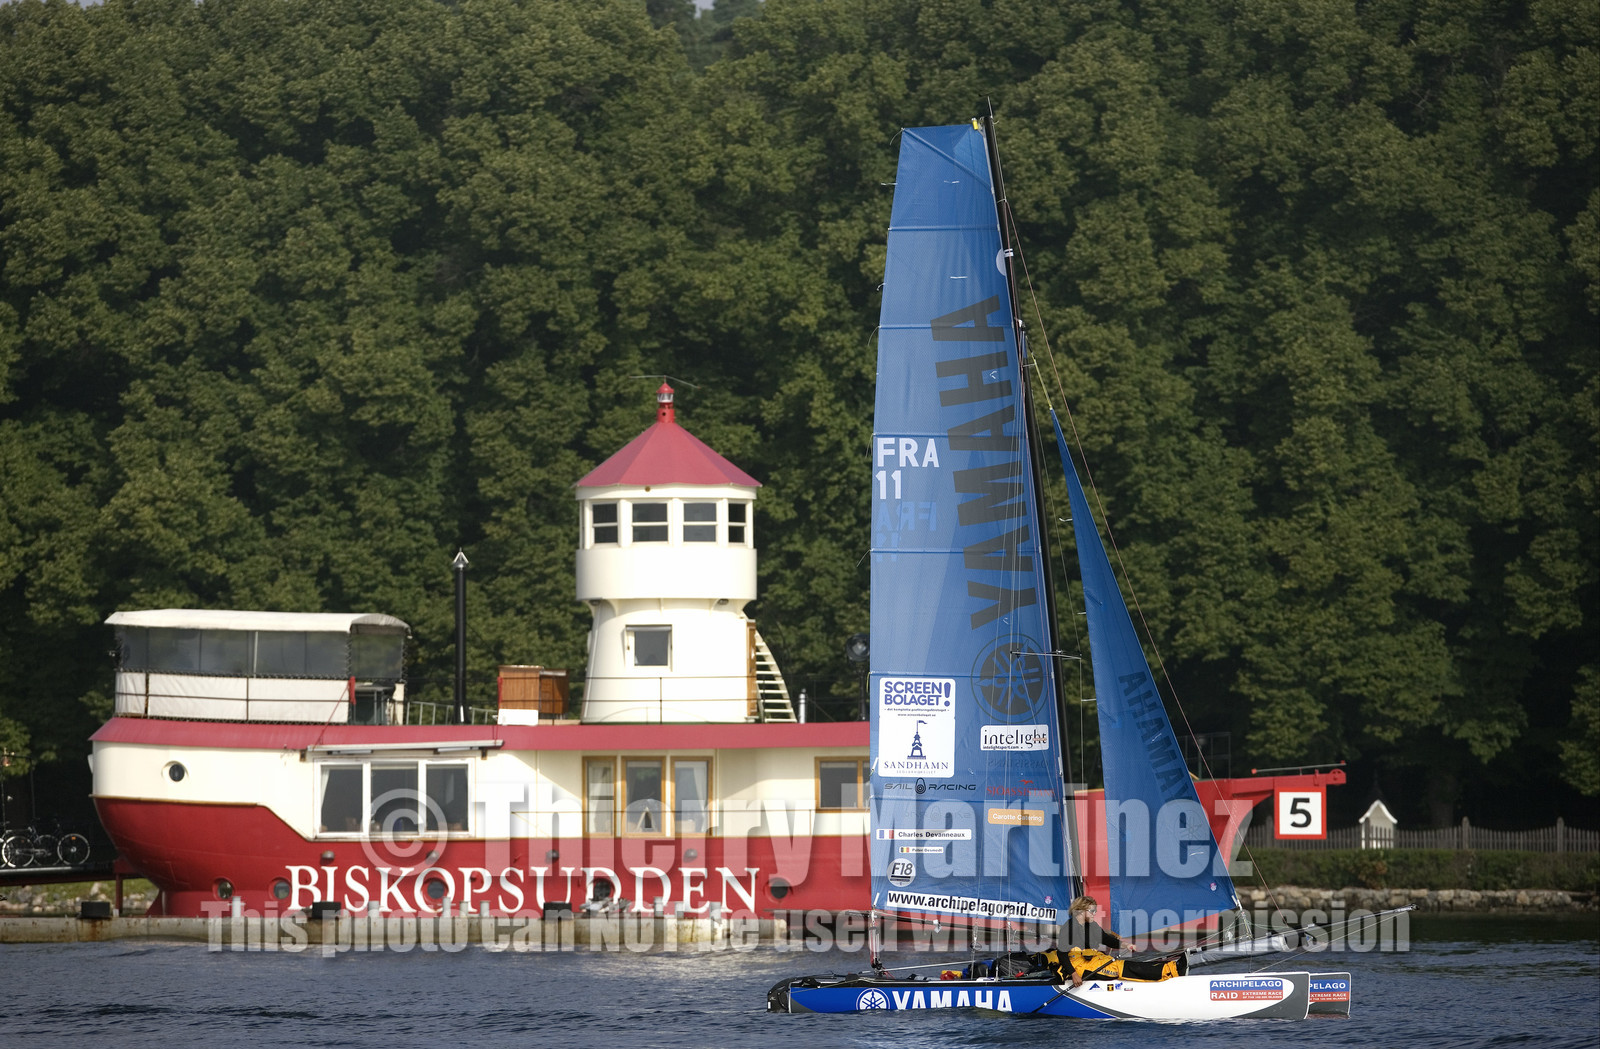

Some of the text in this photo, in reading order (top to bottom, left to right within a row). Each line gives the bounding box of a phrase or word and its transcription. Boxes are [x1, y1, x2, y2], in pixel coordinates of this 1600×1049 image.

[876, 437, 940, 467] FRA
[930, 294, 1037, 630] YAMAHA
[875, 469, 901, 499] 11
[884, 681, 942, 694] SCREEN
[983, 729, 1047, 749] intelight
[1117, 670, 1194, 808] YAMAHA
[884, 761, 949, 769] SANDHAMN
[992, 813, 1043, 823] Carotte Catering
[1290, 797, 1313, 828] 5
[891, 862, 913, 875] F18
[285, 864, 760, 914] BISKOPSUDDEN
[888, 890, 1057, 920] www.archipelagoraid.com
[1211, 980, 1282, 988] ARCHIPELAGO
[891, 990, 1013, 1012] YAMAHA
